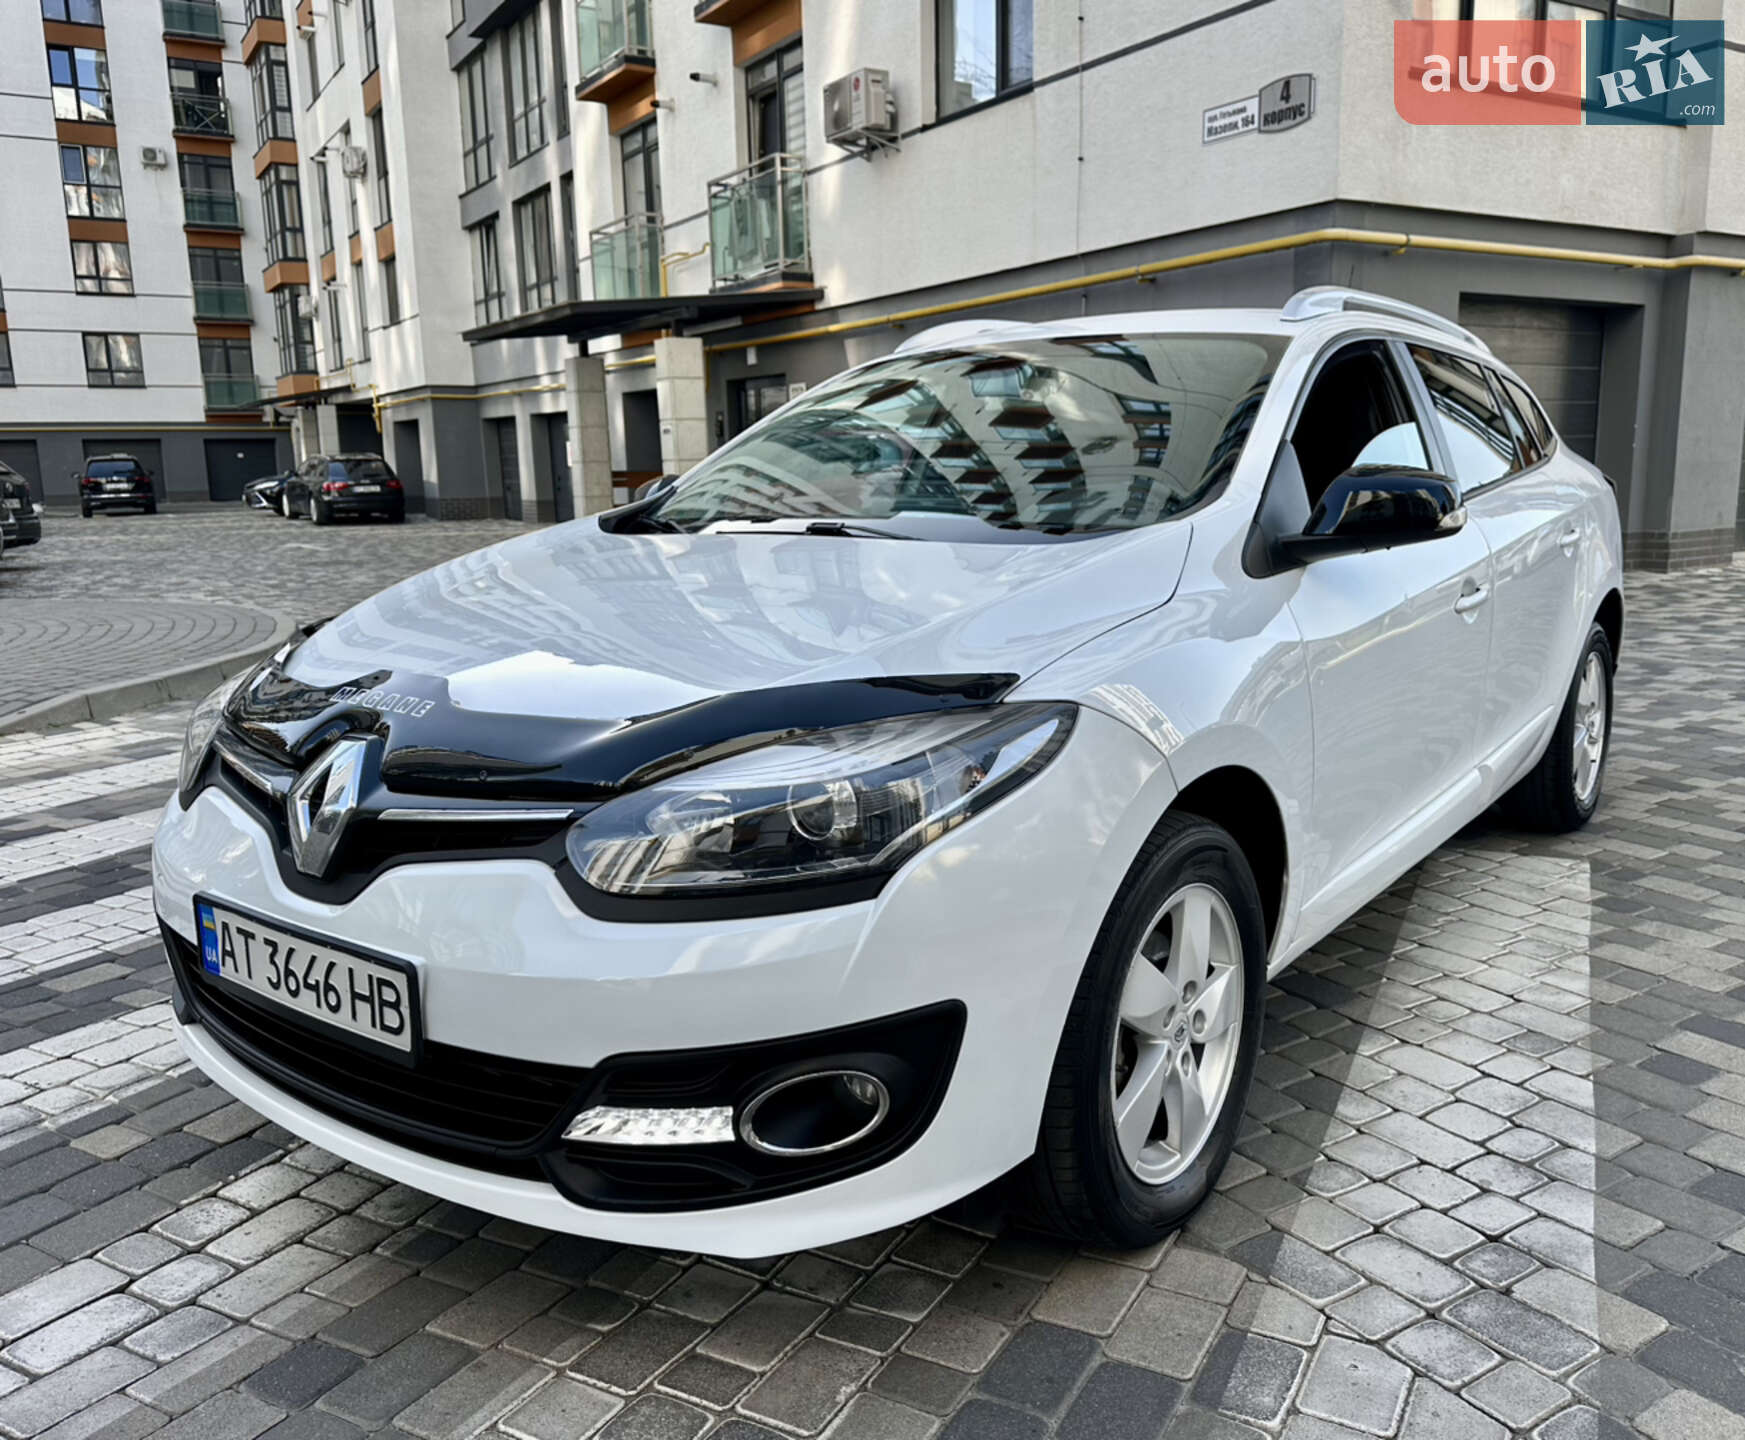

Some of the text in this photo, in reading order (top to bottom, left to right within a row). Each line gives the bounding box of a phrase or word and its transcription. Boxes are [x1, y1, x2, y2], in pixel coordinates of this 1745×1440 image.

[1280, 79, 1291, 104] 4
[1263, 103, 1306, 127] корпус
[329, 686, 436, 717] MEGANE
[205, 945, 218, 965] UA
[221, 920, 405, 1037] AT 3646 HB
